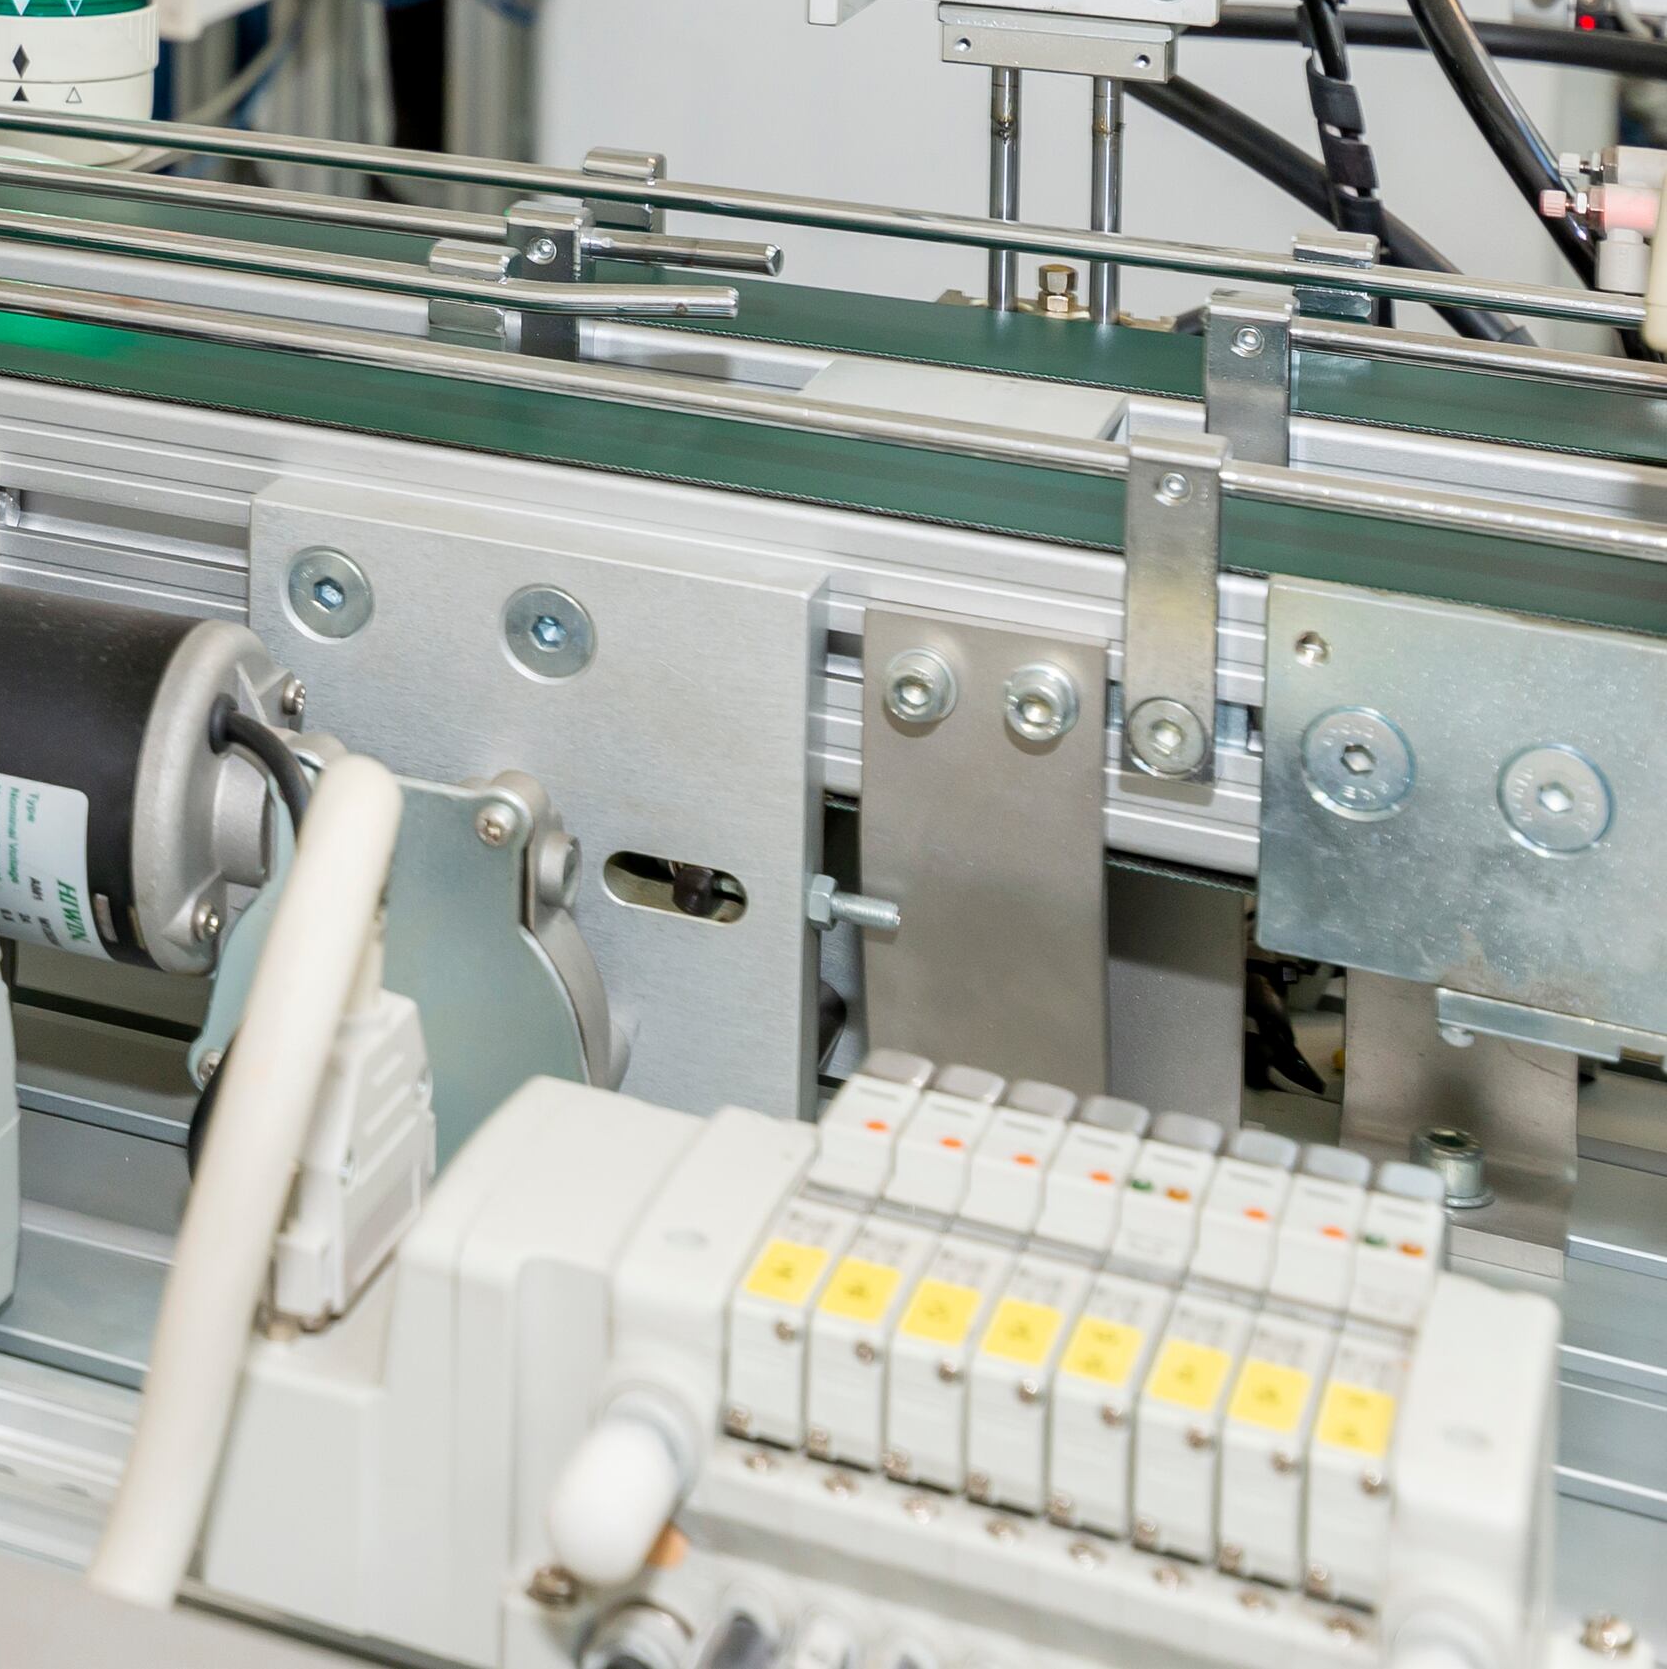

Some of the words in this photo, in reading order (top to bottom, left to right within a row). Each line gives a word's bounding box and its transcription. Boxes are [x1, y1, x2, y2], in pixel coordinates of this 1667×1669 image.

[7, 787, 20, 839] Nominal
[27, 793, 39, 823] Type
[8, 843, 20, 884] Voltage
[56, 878, 91, 943] HIWIN
